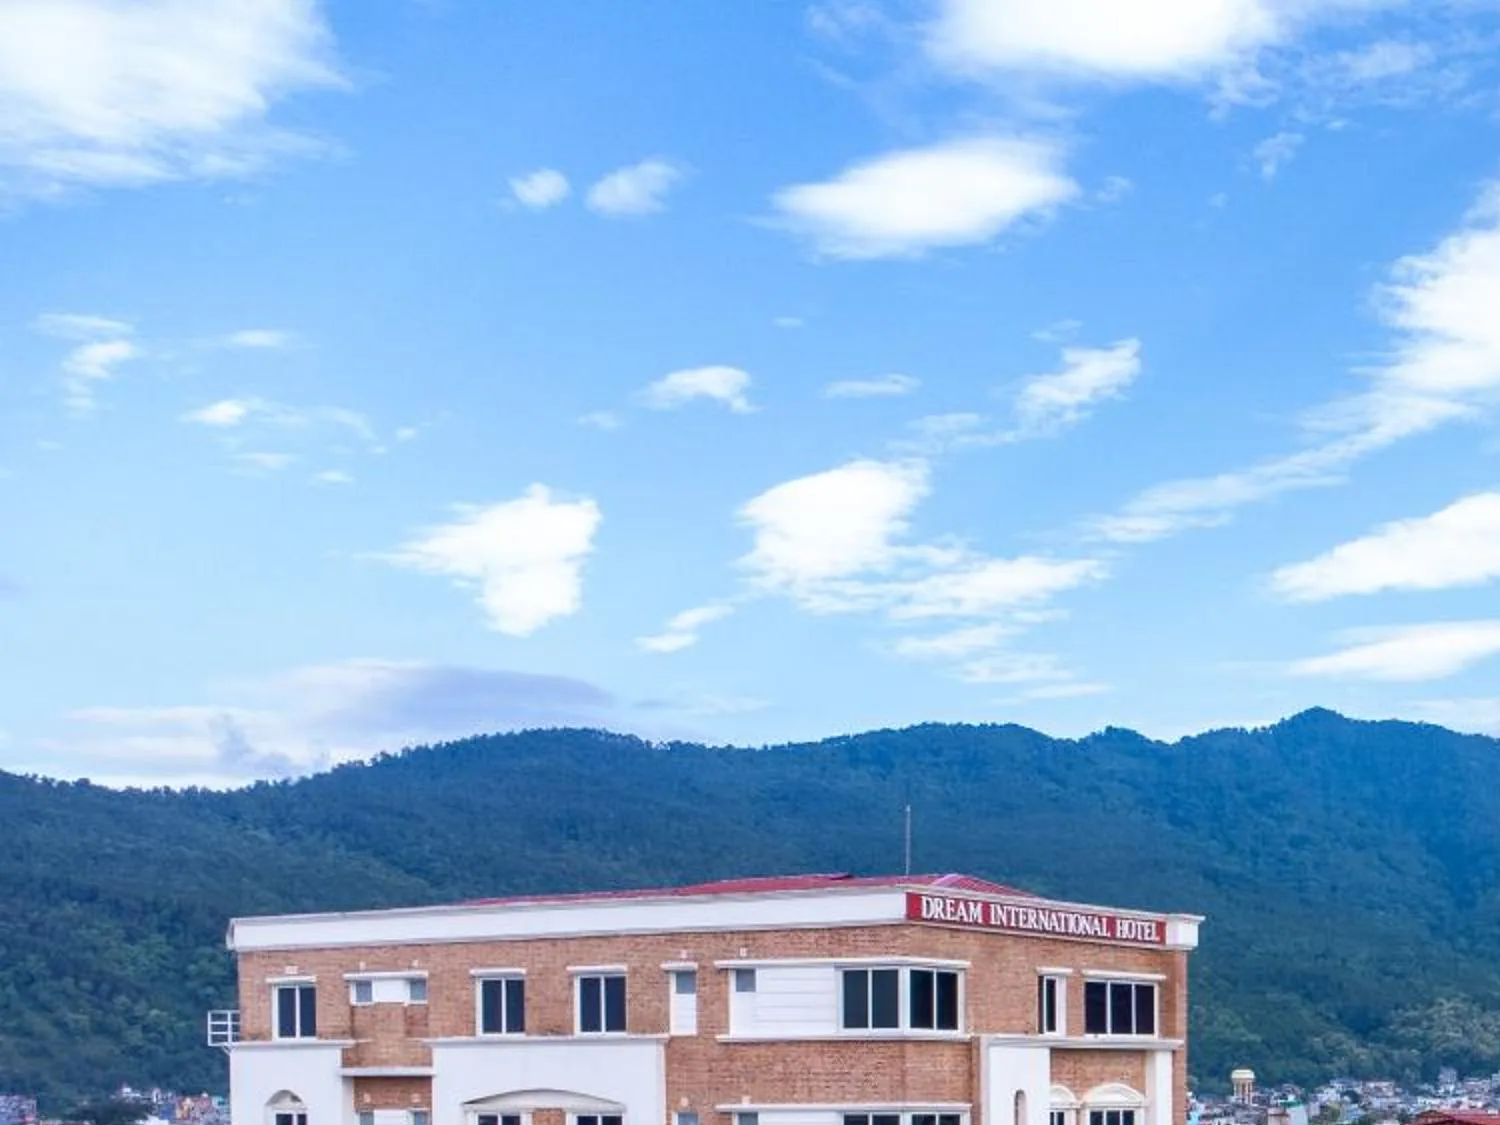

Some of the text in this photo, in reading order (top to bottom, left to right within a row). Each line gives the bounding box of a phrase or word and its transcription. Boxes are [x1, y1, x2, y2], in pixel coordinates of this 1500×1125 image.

[921, 895, 1160, 942] DREAM INTERNATIONAL HOTEL
